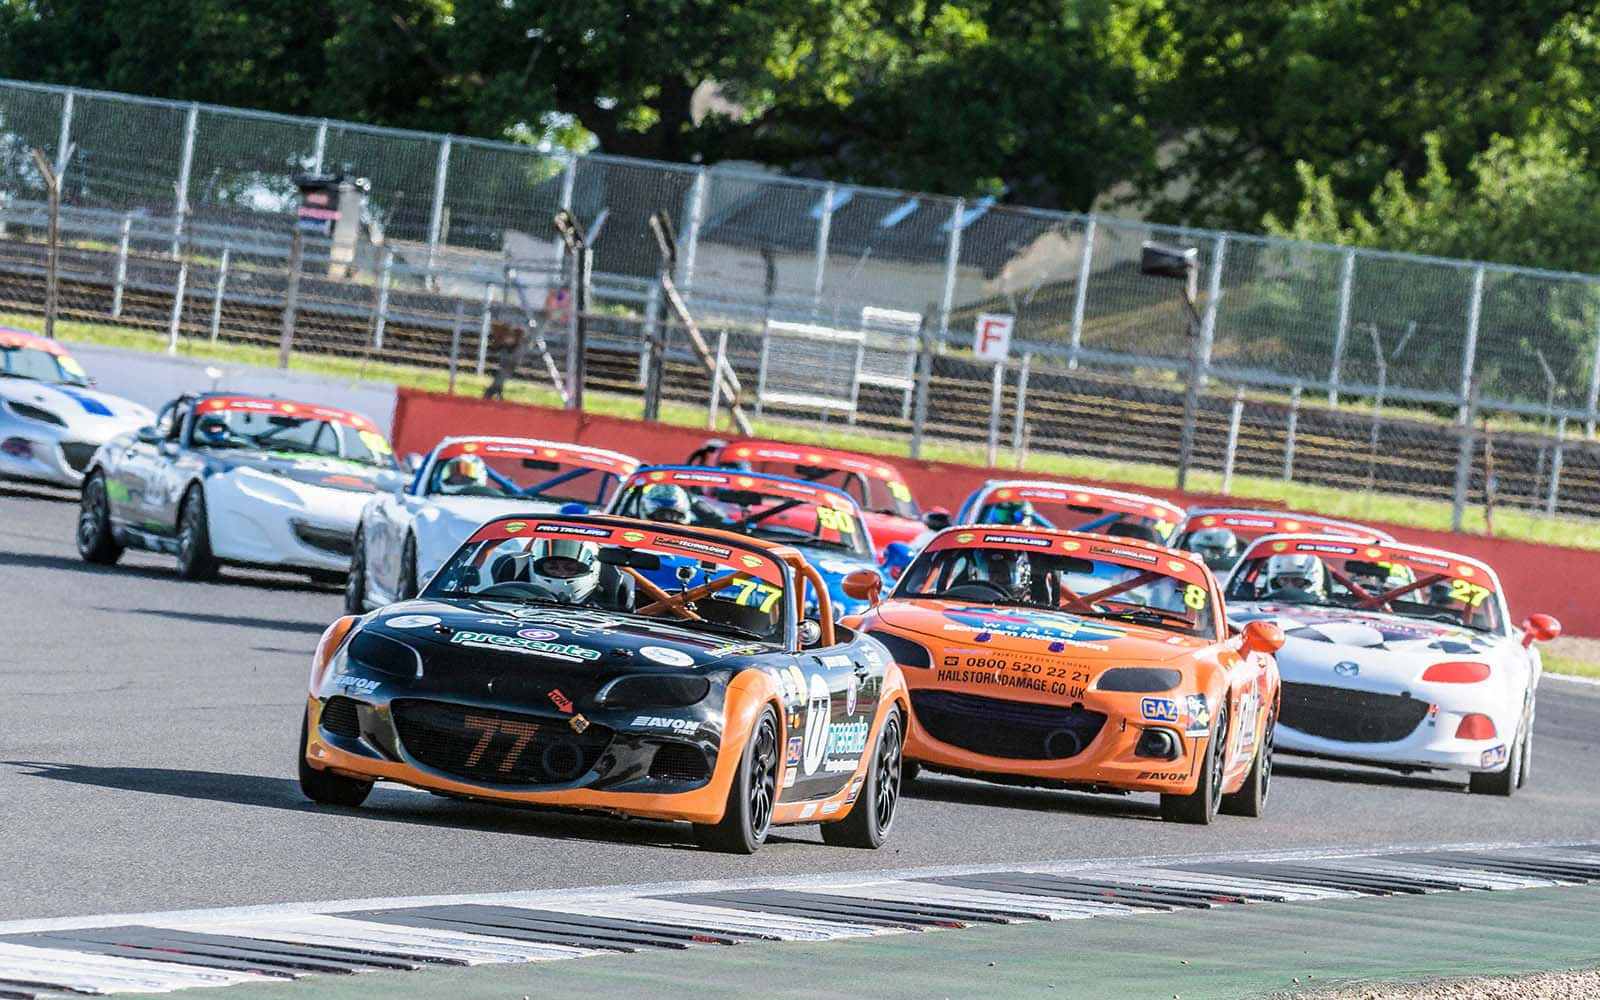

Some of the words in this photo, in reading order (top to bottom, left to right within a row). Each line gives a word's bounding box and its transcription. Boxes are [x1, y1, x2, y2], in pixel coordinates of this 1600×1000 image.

[981, 320, 1008, 353] F
[536, 524, 559, 532] PRO
[816, 506, 856, 533] 50
[732, 577, 783, 614] 77
[1183, 584, 1208, 610] 8
[1448, 578, 1491, 607] 27
[450, 630, 602, 661] presenta
[340, 675, 382, 690] AVON
[966, 657, 1007, 670] 0800
[1011, 661, 1042, 674] 520
[1046, 666, 1067, 679] 22
[1071, 671, 1090, 683] 21
[937, 670, 1086, 699] HAILSTORMDAMAGE.CO.UK
[551, 690, 570, 707] TOW
[1143, 699, 1179, 721] GAZ
[648, 716, 700, 731] AVON
[462, 714, 541, 773] 77
[1149, 772, 1188, 782] AVON
